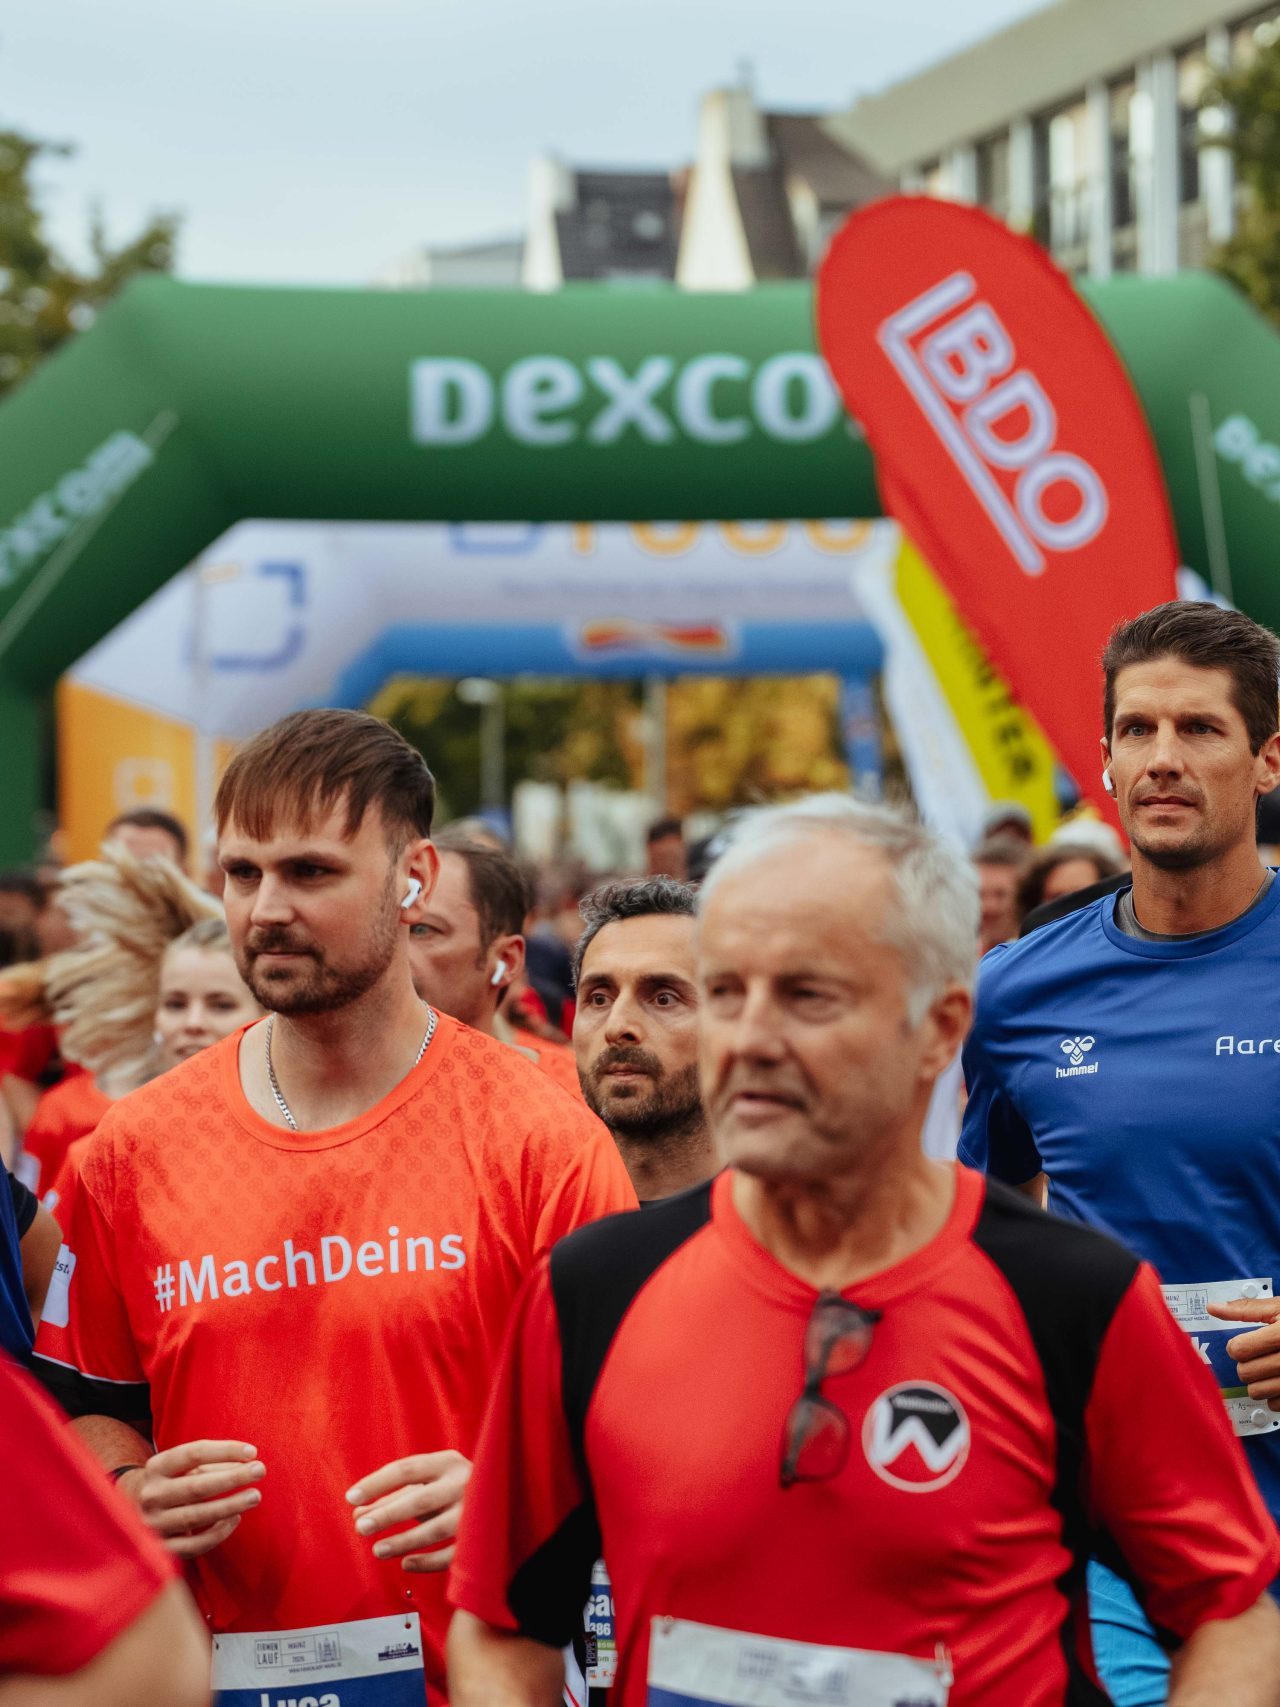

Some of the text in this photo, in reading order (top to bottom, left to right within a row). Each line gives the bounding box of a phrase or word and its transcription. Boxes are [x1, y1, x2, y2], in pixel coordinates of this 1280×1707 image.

[409, 352, 866, 447] Dexco
[922, 300, 1110, 552] BDO
[1055, 1062, 1099, 1079] hummel
[153, 1226, 467, 1313] #MachDeins
[256, 1652, 279, 1665] LAUF
